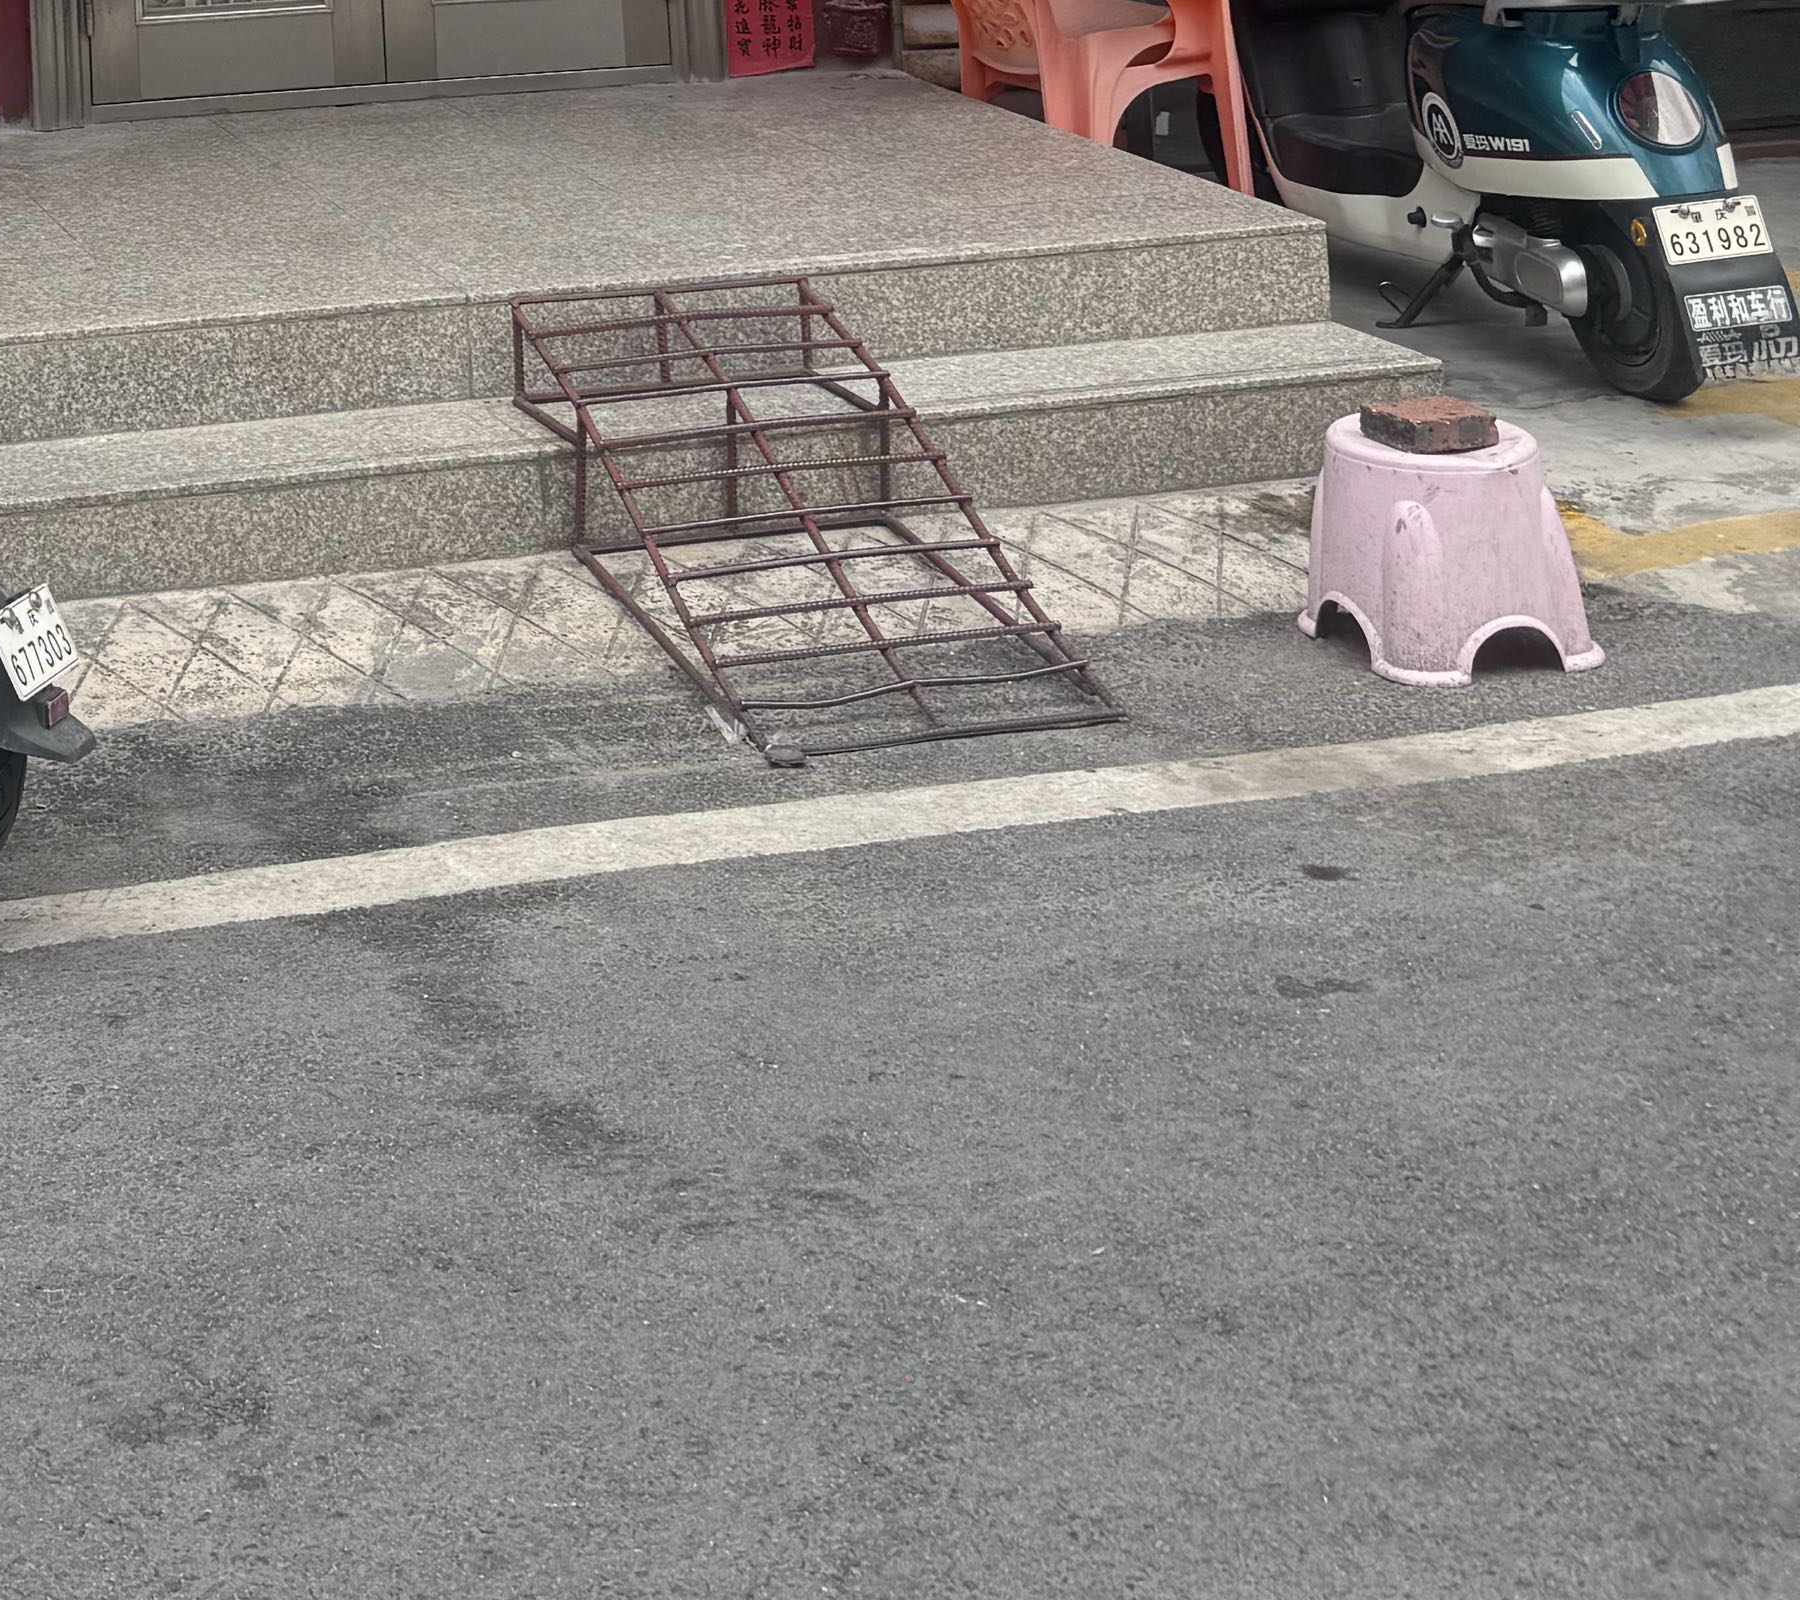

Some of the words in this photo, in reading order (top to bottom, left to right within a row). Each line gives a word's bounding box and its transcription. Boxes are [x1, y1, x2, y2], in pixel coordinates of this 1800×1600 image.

[1670, 223, 1766, 257] 631982
[1687, 288, 1788, 329] 盈利和车行
[10, 623, 72, 687] 677303
